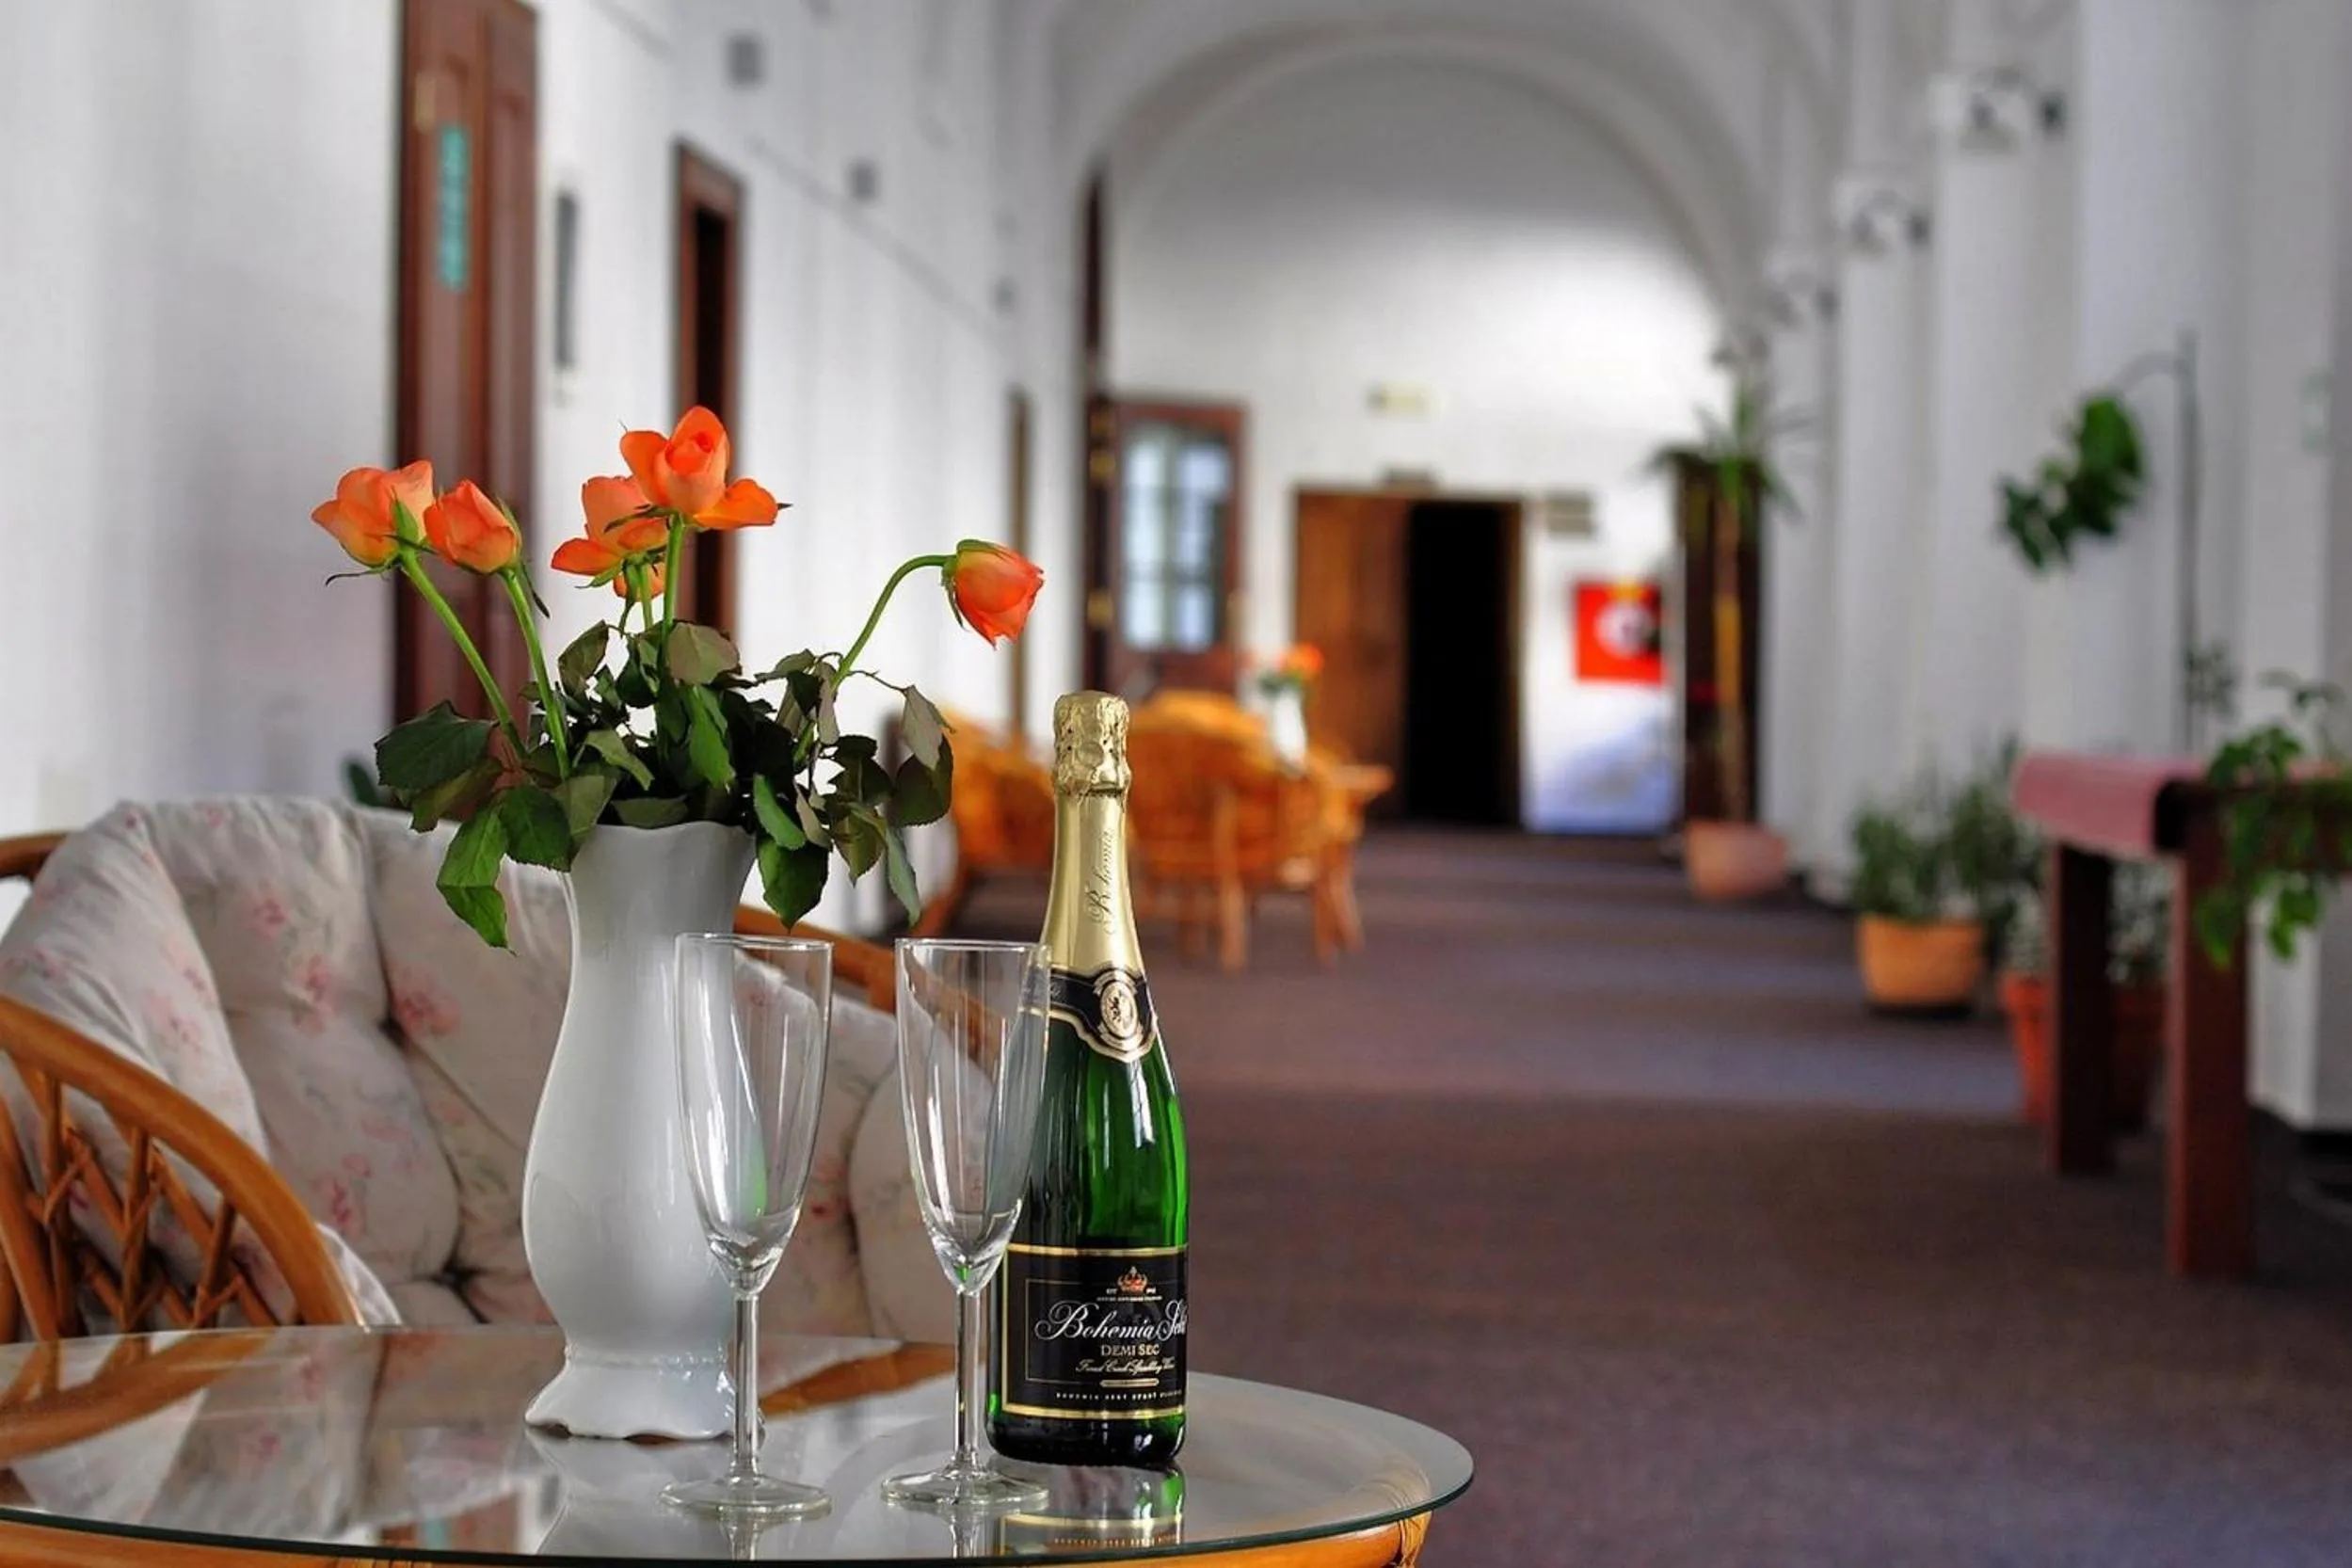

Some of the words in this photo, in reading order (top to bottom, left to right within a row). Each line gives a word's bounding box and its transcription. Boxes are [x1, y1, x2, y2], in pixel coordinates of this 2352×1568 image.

[1083, 828, 1115, 935] Bhemia
[1034, 1300, 1156, 1340] Bohemia
[1100, 1344, 1136, 1356] DEMI
[1138, 1342, 1160, 1355] SEC
